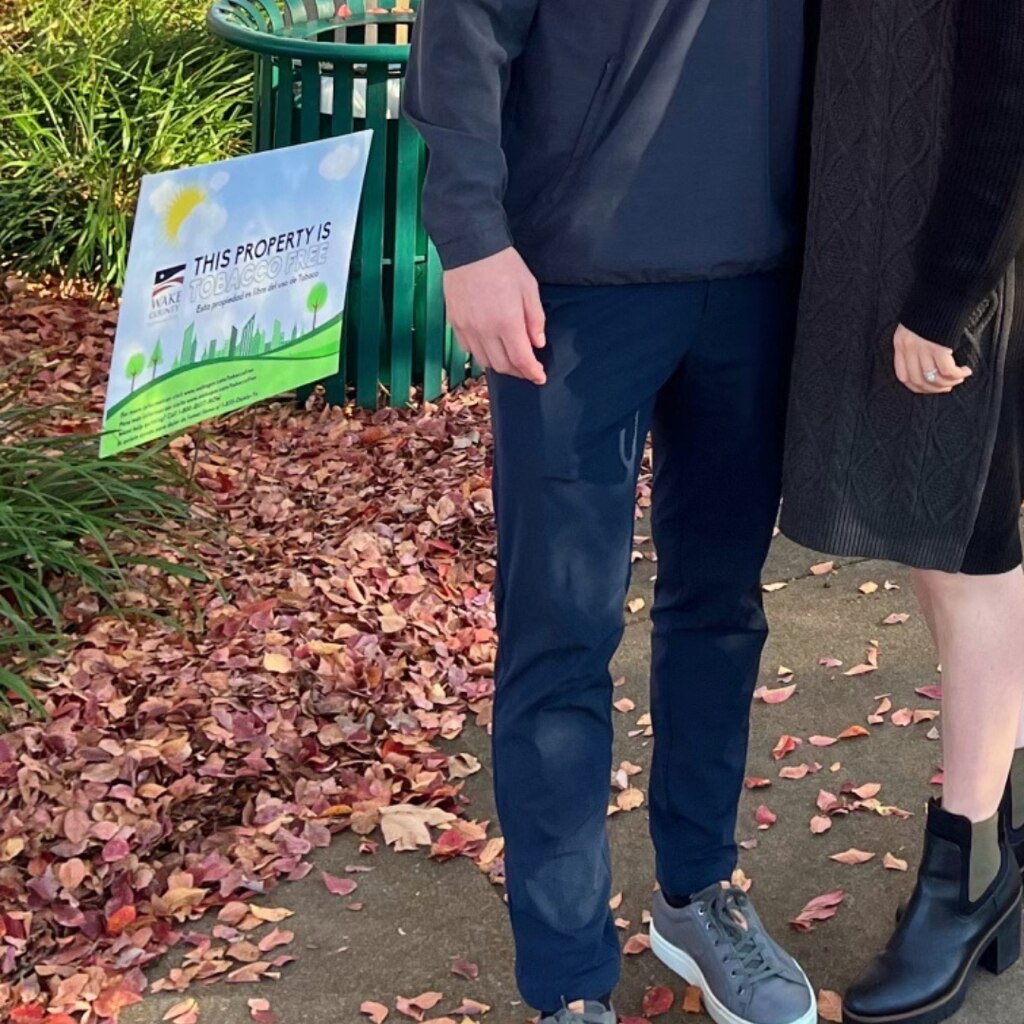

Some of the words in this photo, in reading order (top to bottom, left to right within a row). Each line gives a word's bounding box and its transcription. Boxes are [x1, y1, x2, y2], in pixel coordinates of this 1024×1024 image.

[194, 249, 231, 276] THIS
[235, 226, 315, 265] PROPERTY
[317, 221, 332, 241] IS
[189, 255, 283, 303] TOBACCO
[284, 242, 330, 277] FREE
[149, 304, 181, 319] COUNTY
[151, 291, 184, 310] WAKE
